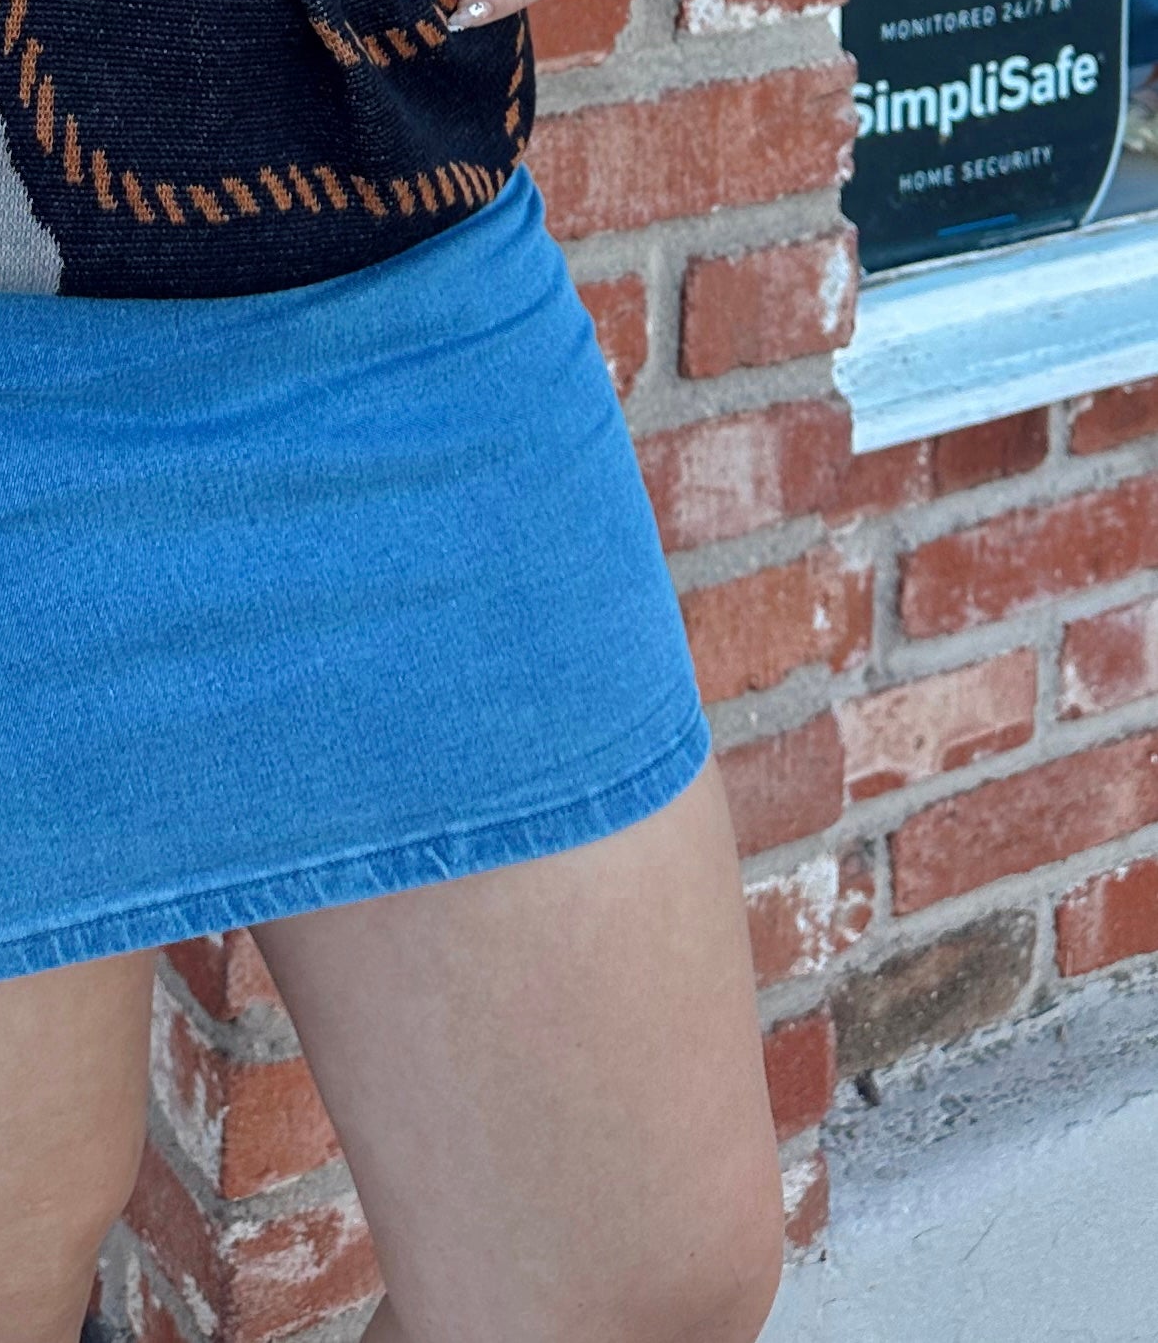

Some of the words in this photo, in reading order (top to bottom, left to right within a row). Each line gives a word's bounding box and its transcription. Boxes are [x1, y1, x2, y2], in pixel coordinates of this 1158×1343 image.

[880, 4, 997, 42] MONITORED
[850, 44, 1100, 137] SimpliSafe
[898, 163, 955, 194] HOME
[961, 144, 1054, 183] SECURITY
